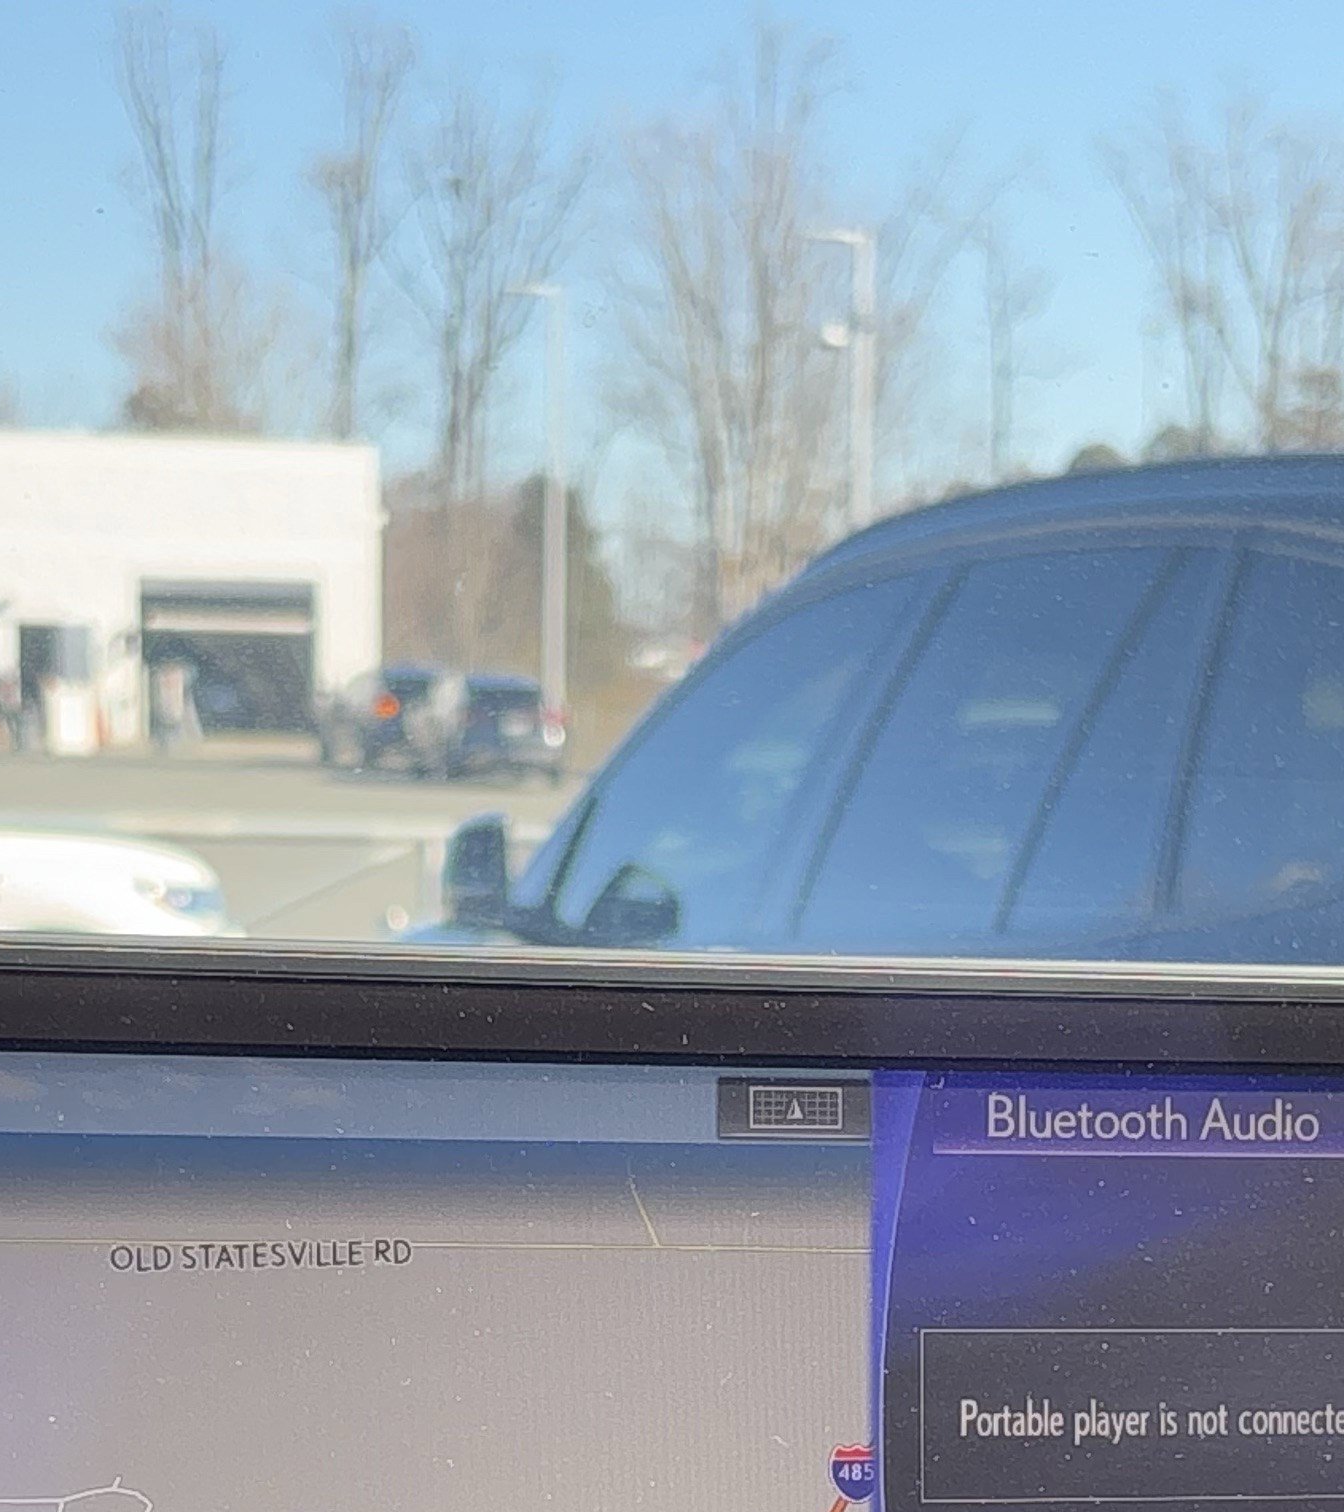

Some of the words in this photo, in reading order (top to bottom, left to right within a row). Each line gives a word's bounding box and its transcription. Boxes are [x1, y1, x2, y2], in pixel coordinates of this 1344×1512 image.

[986, 1093, 1189, 1141] Bluetooth
[1199, 1097, 1320, 1142] Audio
[109, 1244, 172, 1273] OLD
[181, 1240, 364, 1270] STATESVILLE
[374, 1239, 412, 1265] RD
[959, 1398, 1065, 1438] Portable
[1074, 1398, 1150, 1446] player
[1158, 1401, 1178, 1436] is
[1187, 1403, 1229, 1437] not
[838, 1462, 875, 1482] 485
